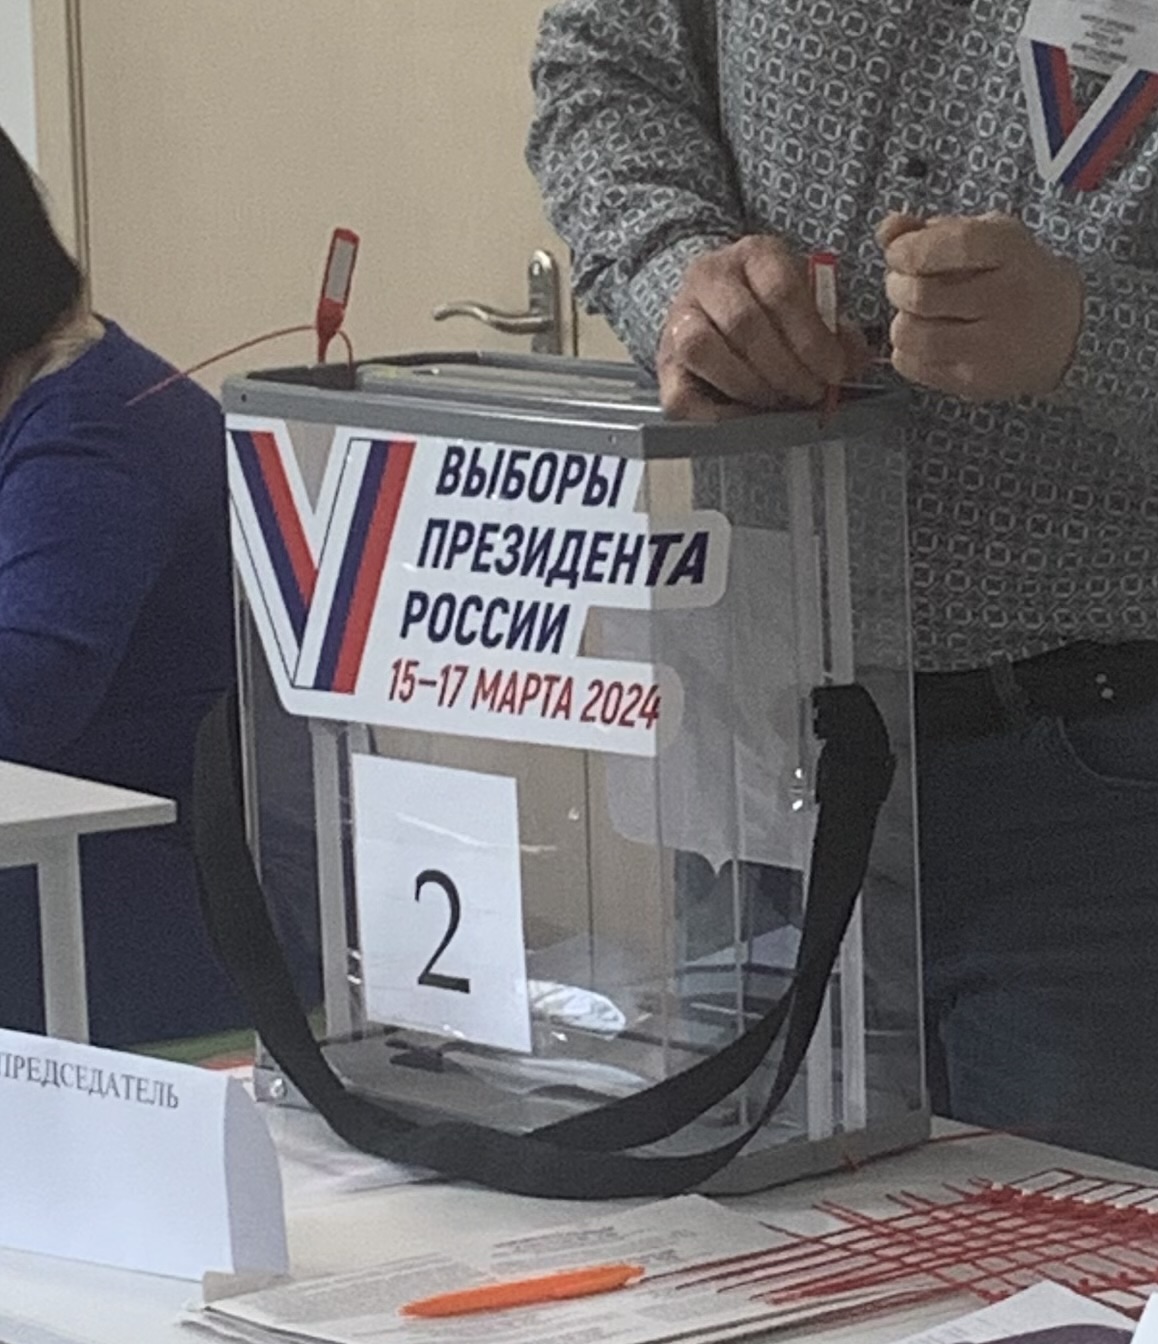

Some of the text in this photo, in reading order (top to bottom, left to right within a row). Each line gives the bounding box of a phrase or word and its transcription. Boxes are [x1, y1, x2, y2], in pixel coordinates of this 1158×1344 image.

[434, 444, 628, 509] ВЫБОРЫ
[416, 517, 710, 591] ПРЕЗИДЕНТА
[399, 590, 572, 655] РОССИИ
[469, 667, 573, 722] МАРТА
[580, 679, 662, 731] 2024
[414, 869, 471, 995] 2
[0, 1052, 179, 1109] ПРЕДСЕДАТЕЛЬ
